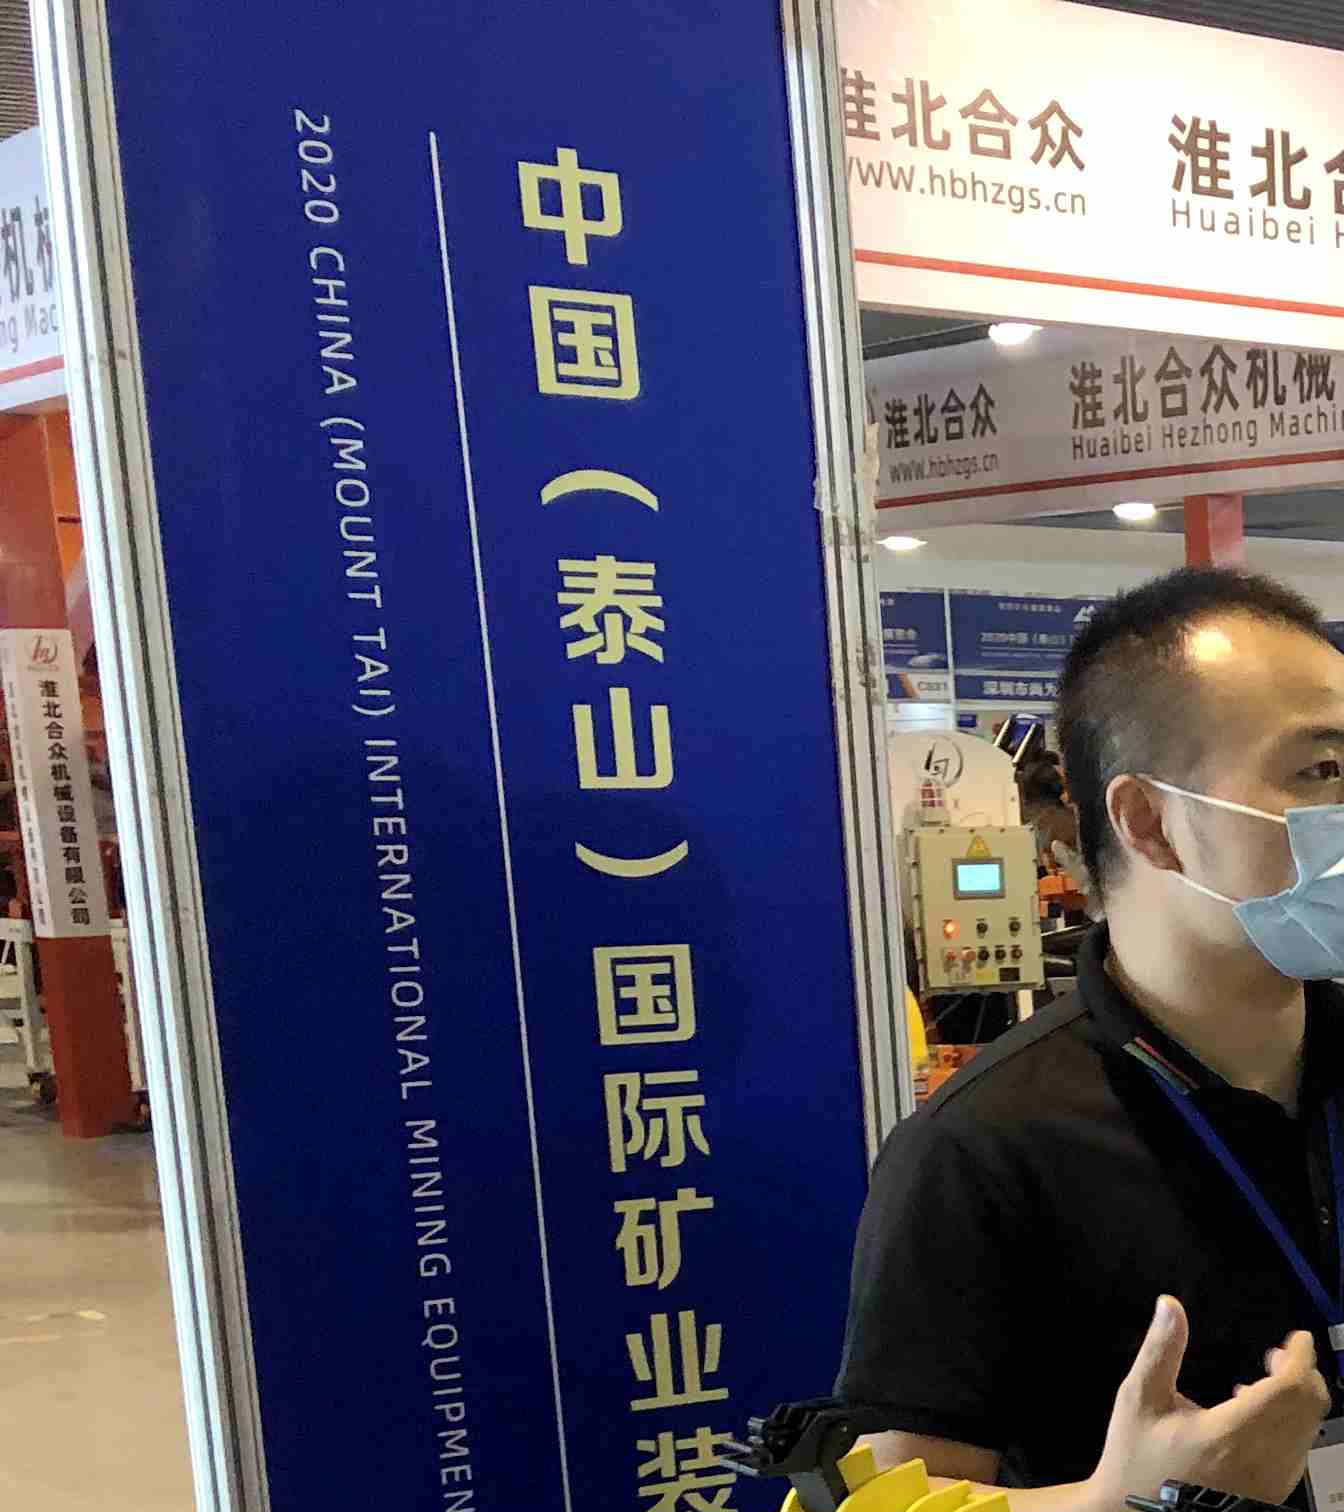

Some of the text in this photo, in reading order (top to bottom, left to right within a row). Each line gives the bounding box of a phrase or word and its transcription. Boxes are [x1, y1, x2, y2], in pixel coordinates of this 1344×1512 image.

[292, 107, 340, 226] 2020
[1171, 197, 1316, 246] Huaibei
[309, 245, 358, 396] CHINA
[884, 383, 998, 449] 淮北合众
[1071, 426, 1153, 461] Huaibei
[1161, 418, 1258, 450] Hezhong
[319, 415, 383, 610] (MOUNT
[351, 625, 396, 718] TAI)
[363, 738, 433, 1100] INTERNATIONAL
[404, 1118, 452, 1278] MINING
